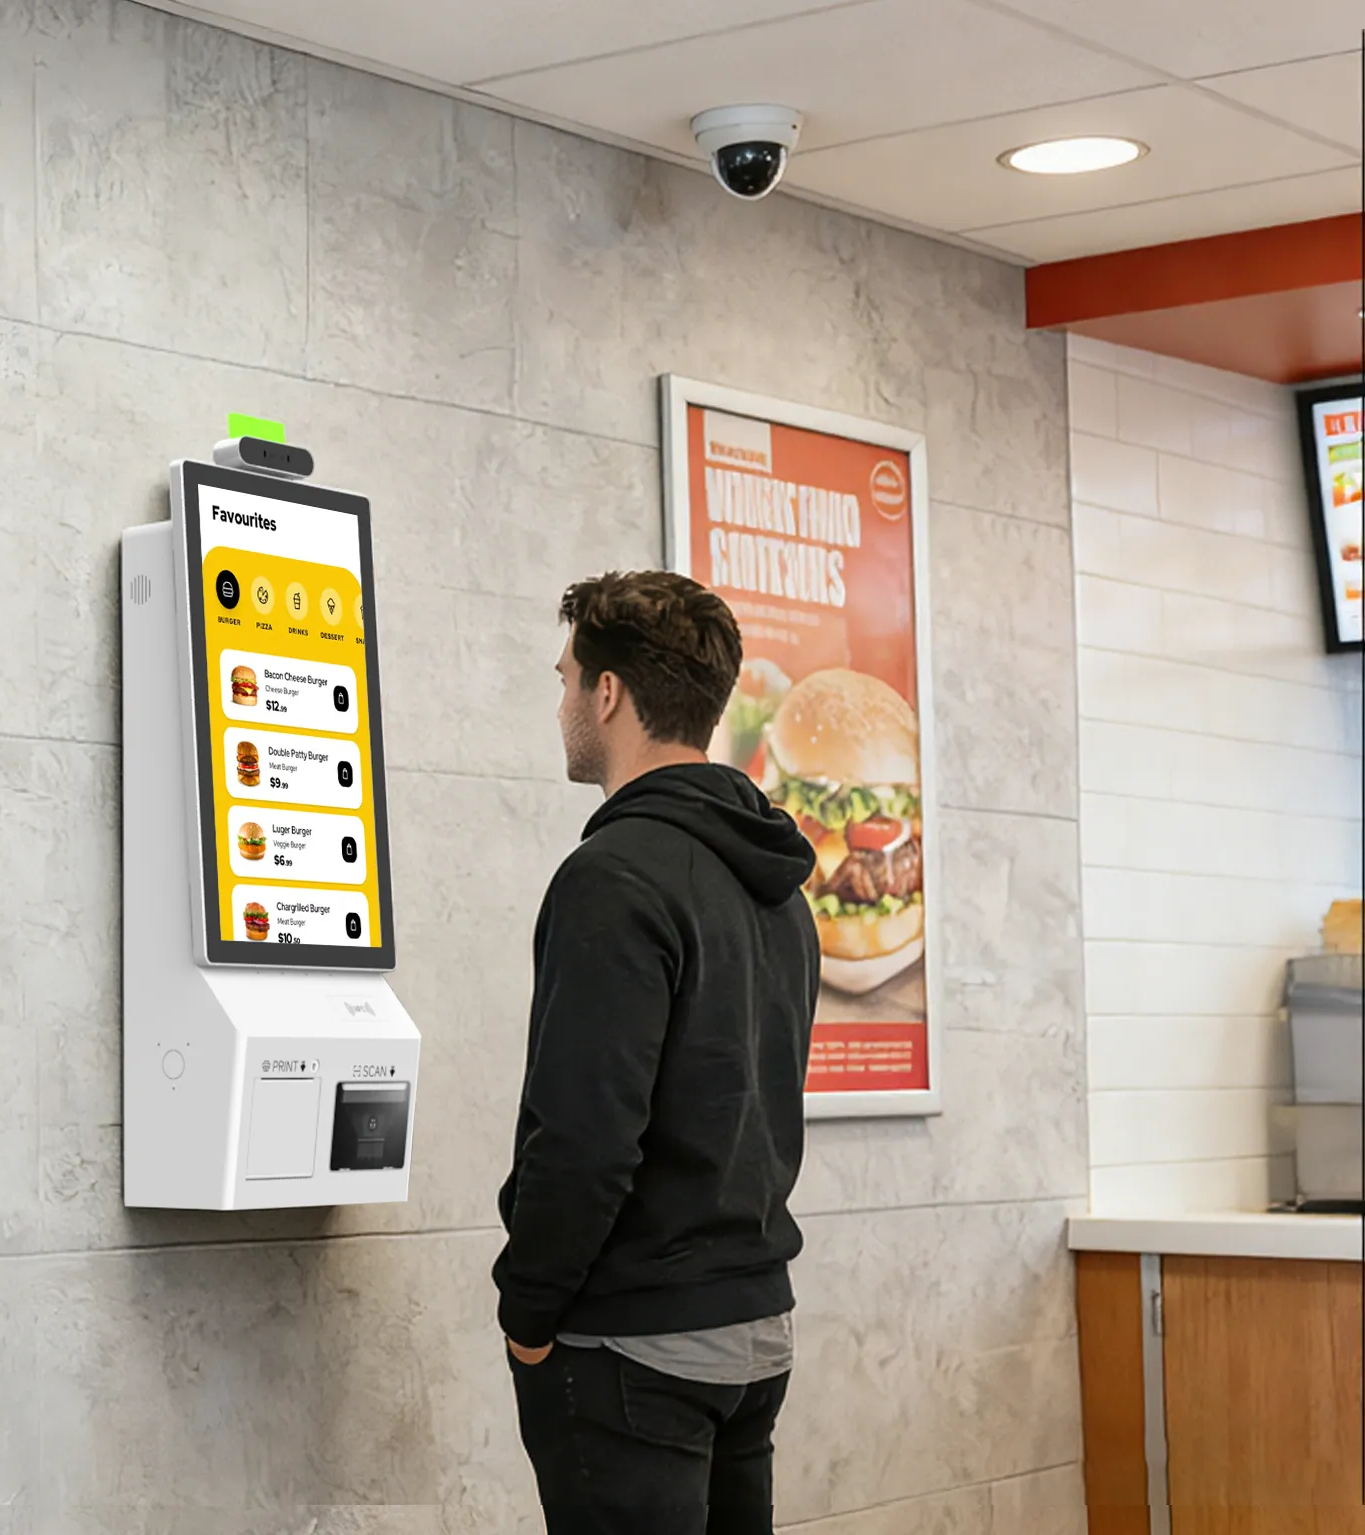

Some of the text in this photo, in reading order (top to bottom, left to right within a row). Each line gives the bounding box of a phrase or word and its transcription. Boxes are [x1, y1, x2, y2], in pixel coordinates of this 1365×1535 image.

[212, 504, 278, 532] Favourites
[217, 616, 242, 626] BURGER
[255, 622, 274, 631] PIZZA
[288, 627, 309, 637] DRINKS
[320, 631, 345, 642] DESSERT
[264, 669, 328, 688] Bacon Cheese Burger
[265, 684, 300, 698] Cheese Burger
[268, 746, 329, 763] Double Patty Burger
[272, 823, 313, 838] Luger Burger
[276, 901, 331, 916] Chargrilled Burger
[272, 1060, 299, 1072] PRINT
[363, 1065, 387, 1077] SCAN
